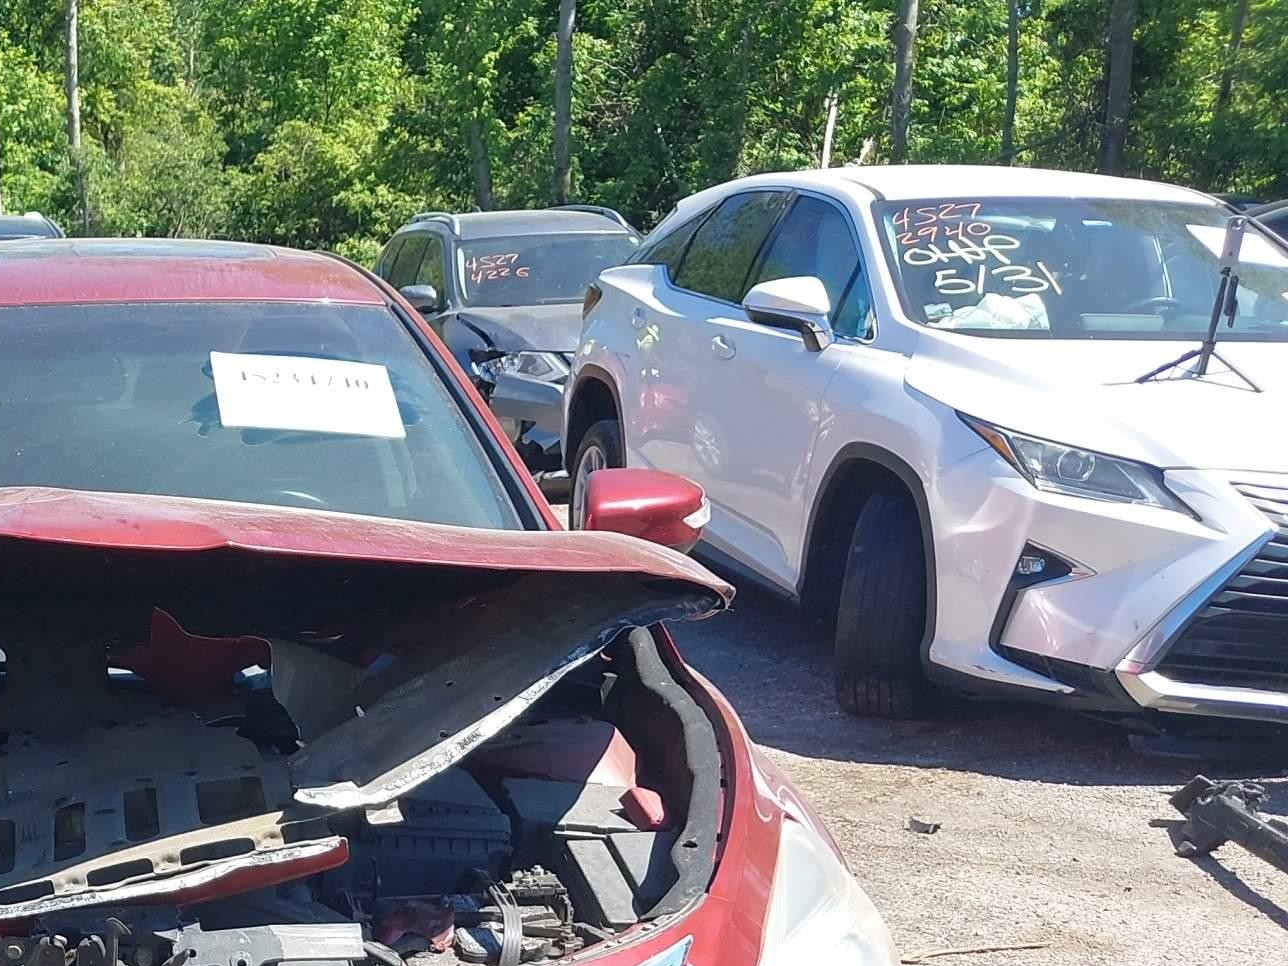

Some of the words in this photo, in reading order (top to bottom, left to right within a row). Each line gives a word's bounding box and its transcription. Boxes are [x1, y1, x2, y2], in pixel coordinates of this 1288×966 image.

[892, 203, 981, 230] 4527
[897, 221, 991, 245] 2940
[465, 253, 519, 270] 4527
[471, 266, 530, 284] 4226
